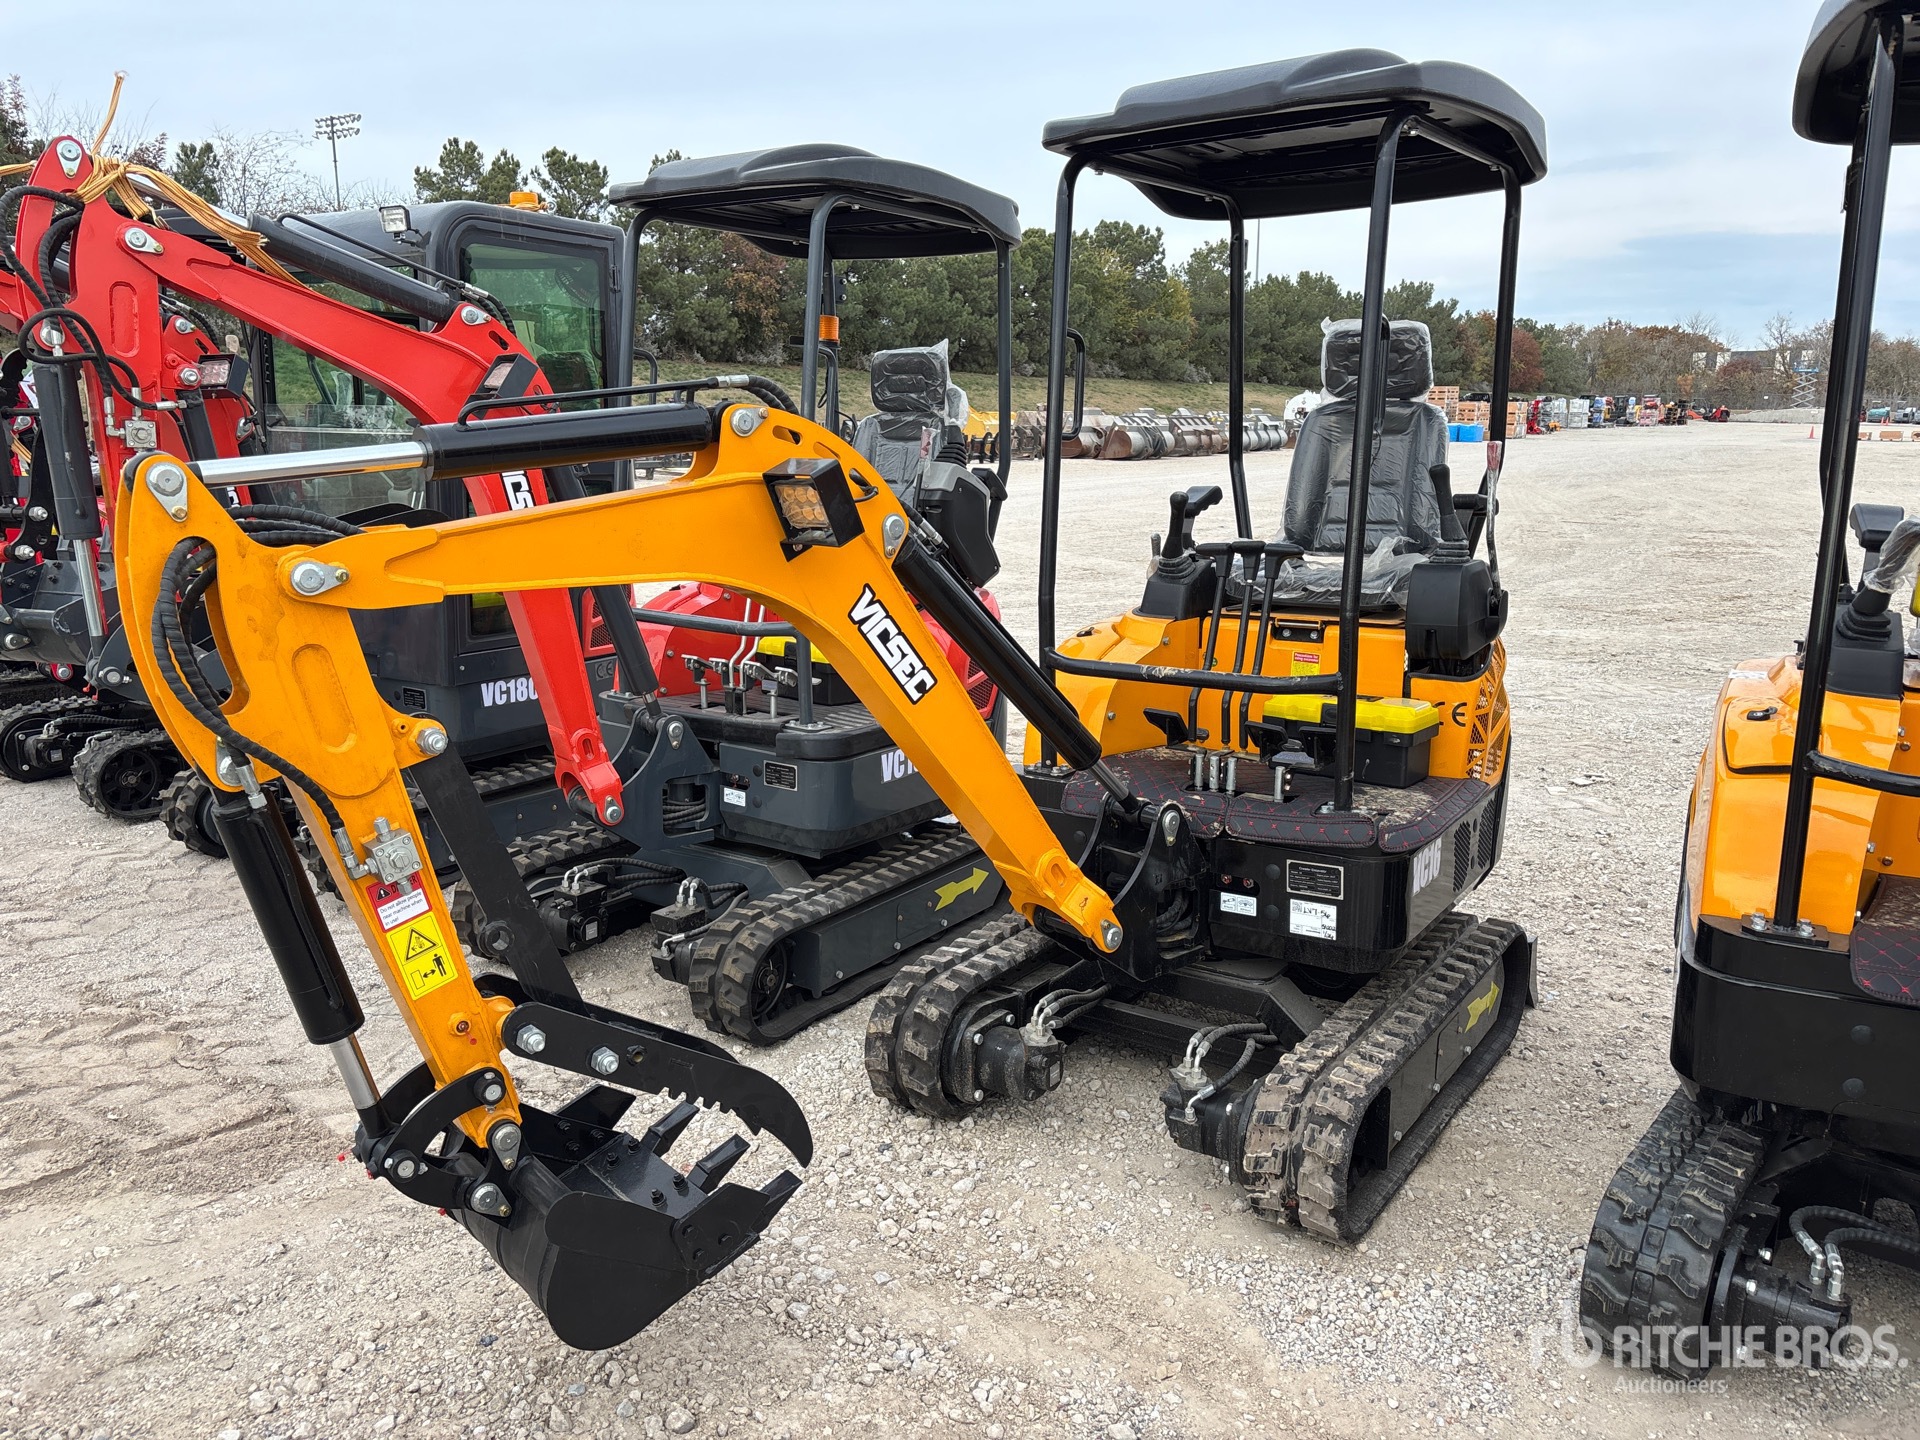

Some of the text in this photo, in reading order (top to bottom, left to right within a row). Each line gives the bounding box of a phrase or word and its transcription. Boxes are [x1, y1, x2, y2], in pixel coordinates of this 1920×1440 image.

[849, 584, 937, 704] VICSEC
[881, 749, 919, 783] VC1
[1412, 837, 1442, 897] VC16
[383, 898, 424, 920] near machine when
[407, 891, 422, 902] people
